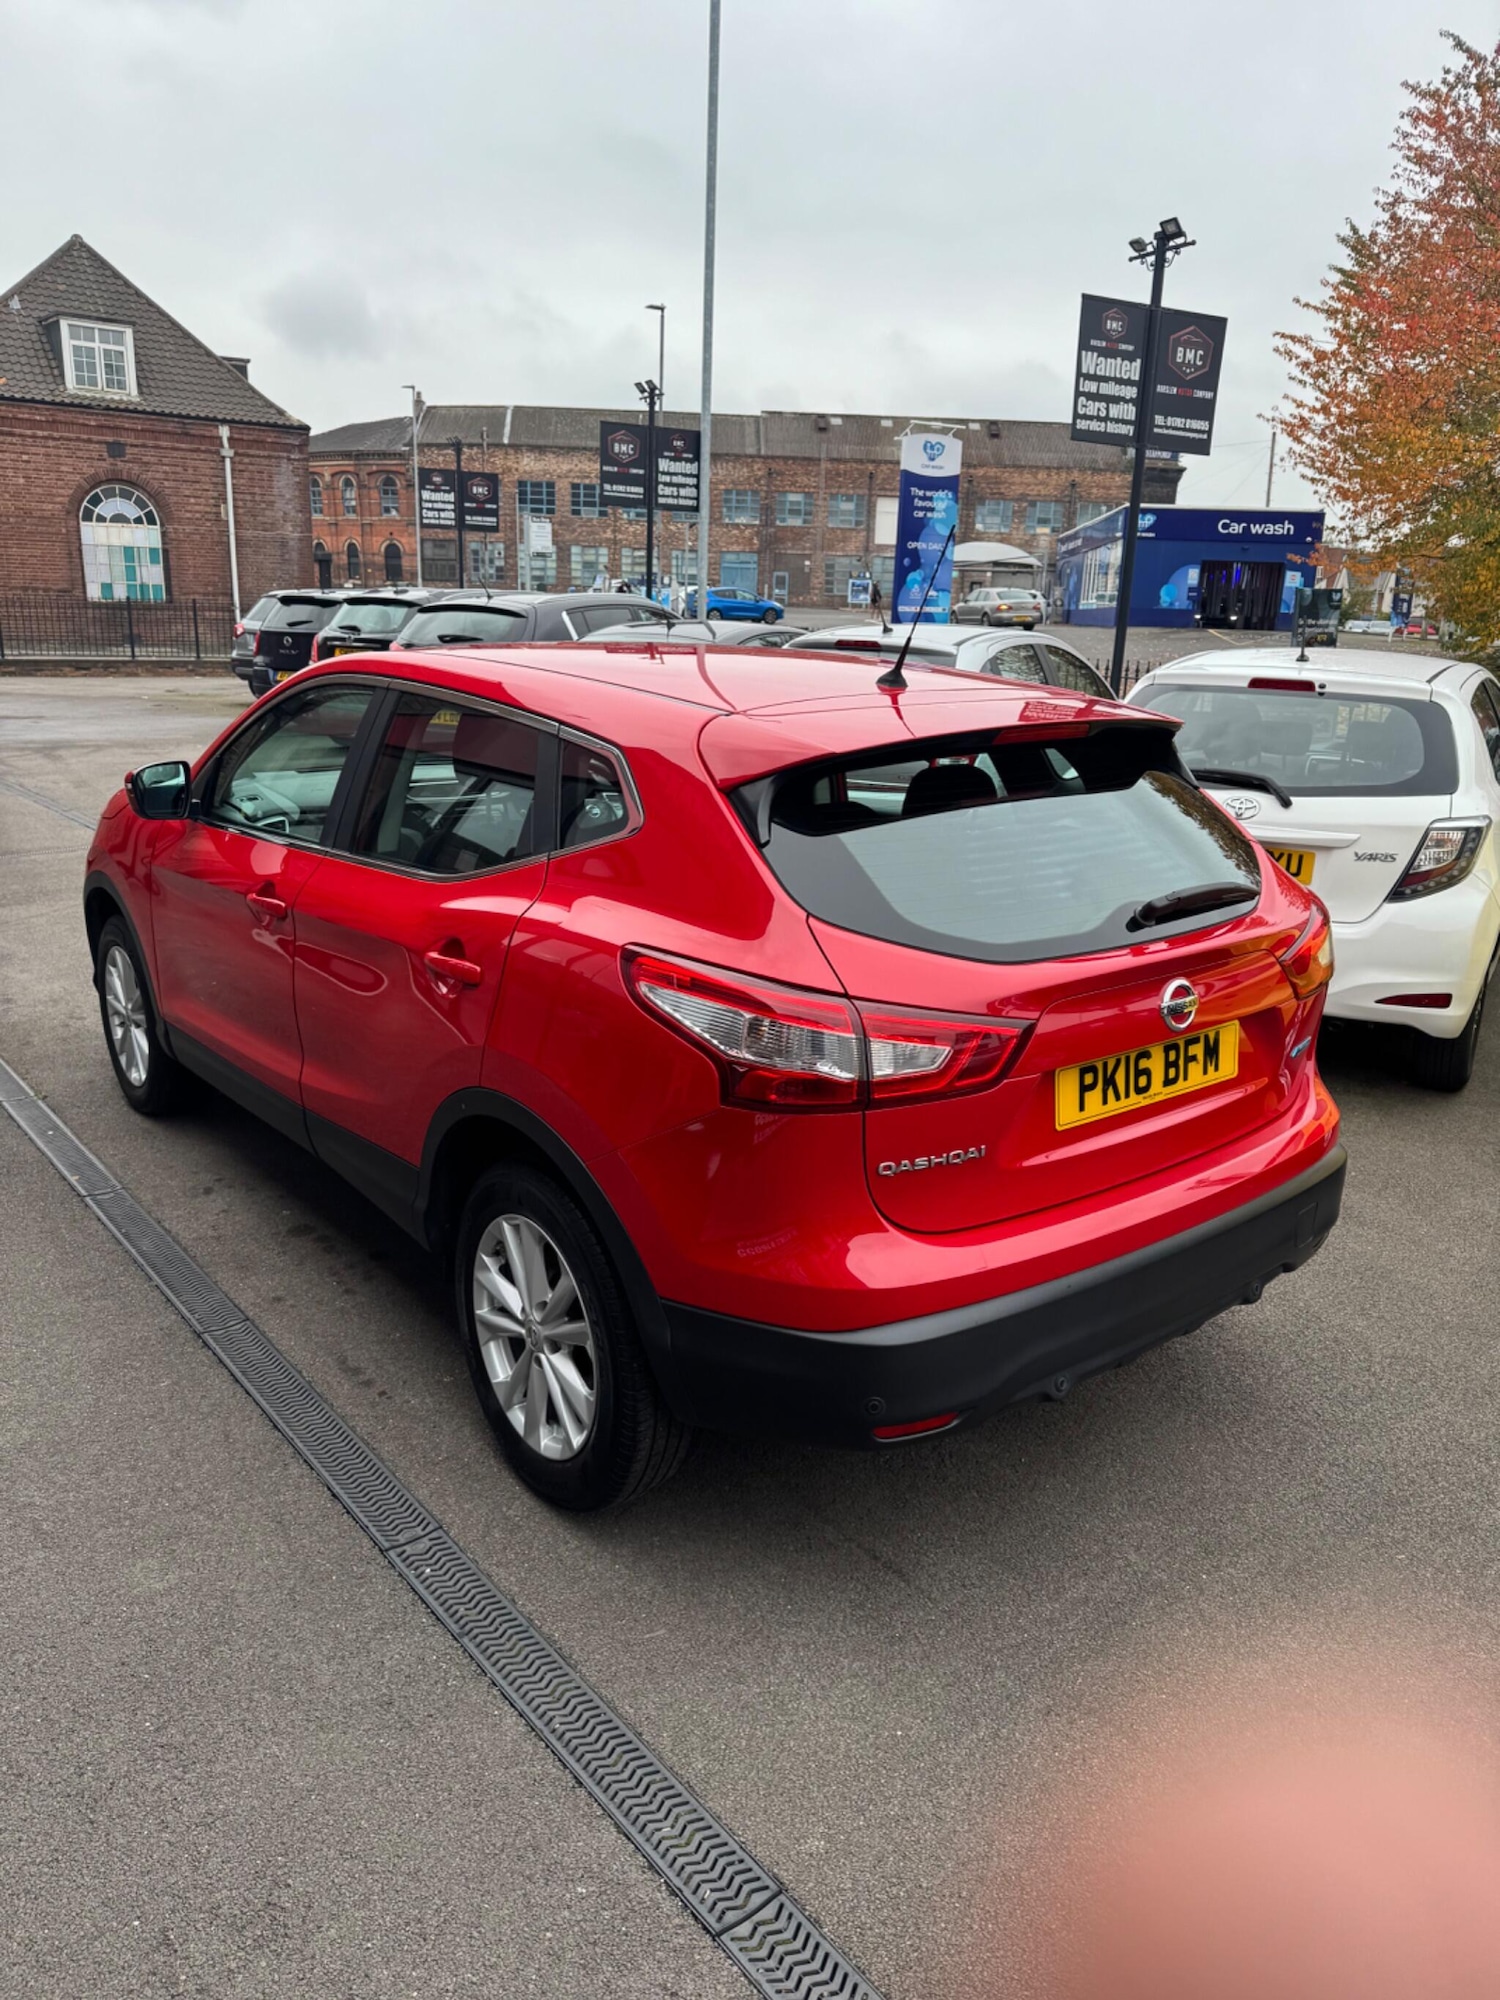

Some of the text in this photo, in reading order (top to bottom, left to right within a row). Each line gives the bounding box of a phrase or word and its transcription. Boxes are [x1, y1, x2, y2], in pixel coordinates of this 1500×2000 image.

[1106, 319, 1123, 331] BMC
[1176, 346, 1205, 366] BMC
[1081, 350, 1142, 381] Wanted
[1079, 376, 1138, 399] Low mileage
[1077, 396, 1137, 421] Cars with
[1076, 418, 1135, 436] service history
[613, 442, 635, 455] BMC
[657, 458, 699, 475] Wanted
[420, 489, 455, 503] Wanted
[657, 483, 678, 497] Cars
[678, 486, 698, 498] with
[909, 486, 953, 498] The world's
[913, 510, 946, 519] car wash
[1217, 519, 1295, 536] Car wash
[907, 541, 928, 550] OPEN
[1166, 998, 1197, 1015] NISSAN
[1078, 1030, 1221, 1113] PK16 BFM
